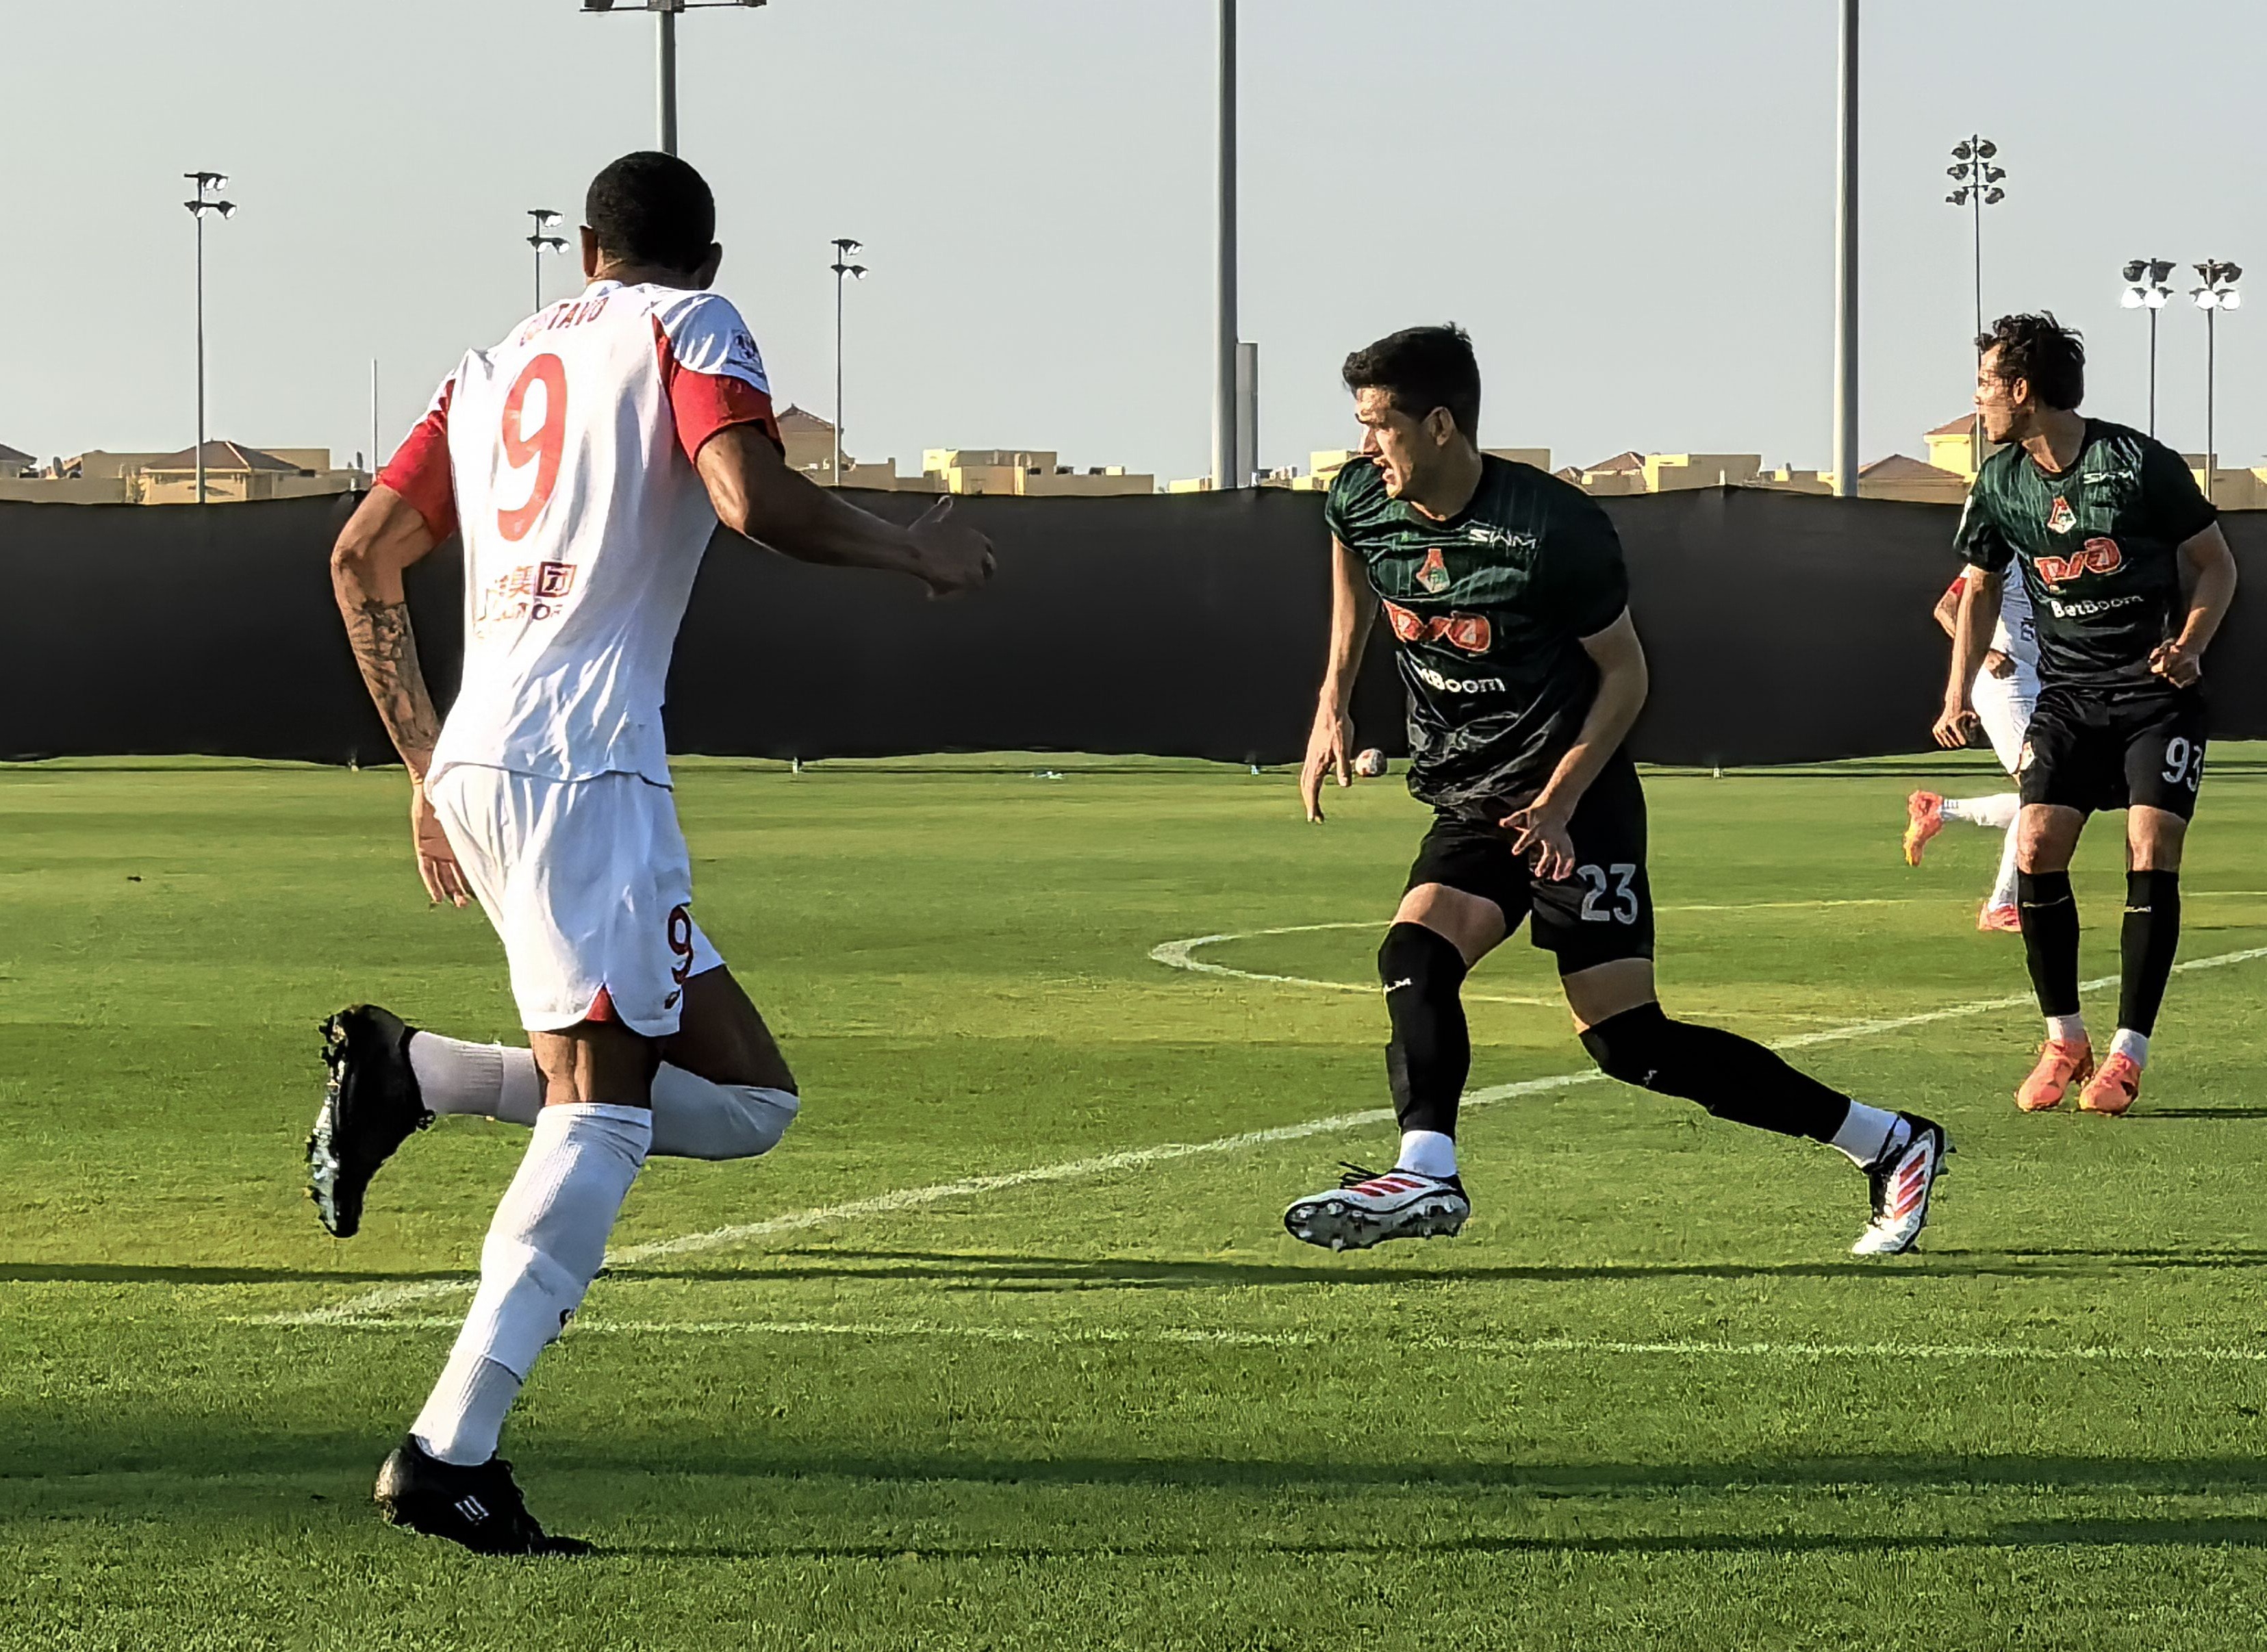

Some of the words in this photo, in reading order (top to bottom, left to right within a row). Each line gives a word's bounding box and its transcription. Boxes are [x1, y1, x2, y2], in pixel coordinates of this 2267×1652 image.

[497, 353, 568, 542] 9
[2162, 737, 2203, 792] 93
[1576, 864, 1638, 924] 23
[668, 903, 694, 985] 9
